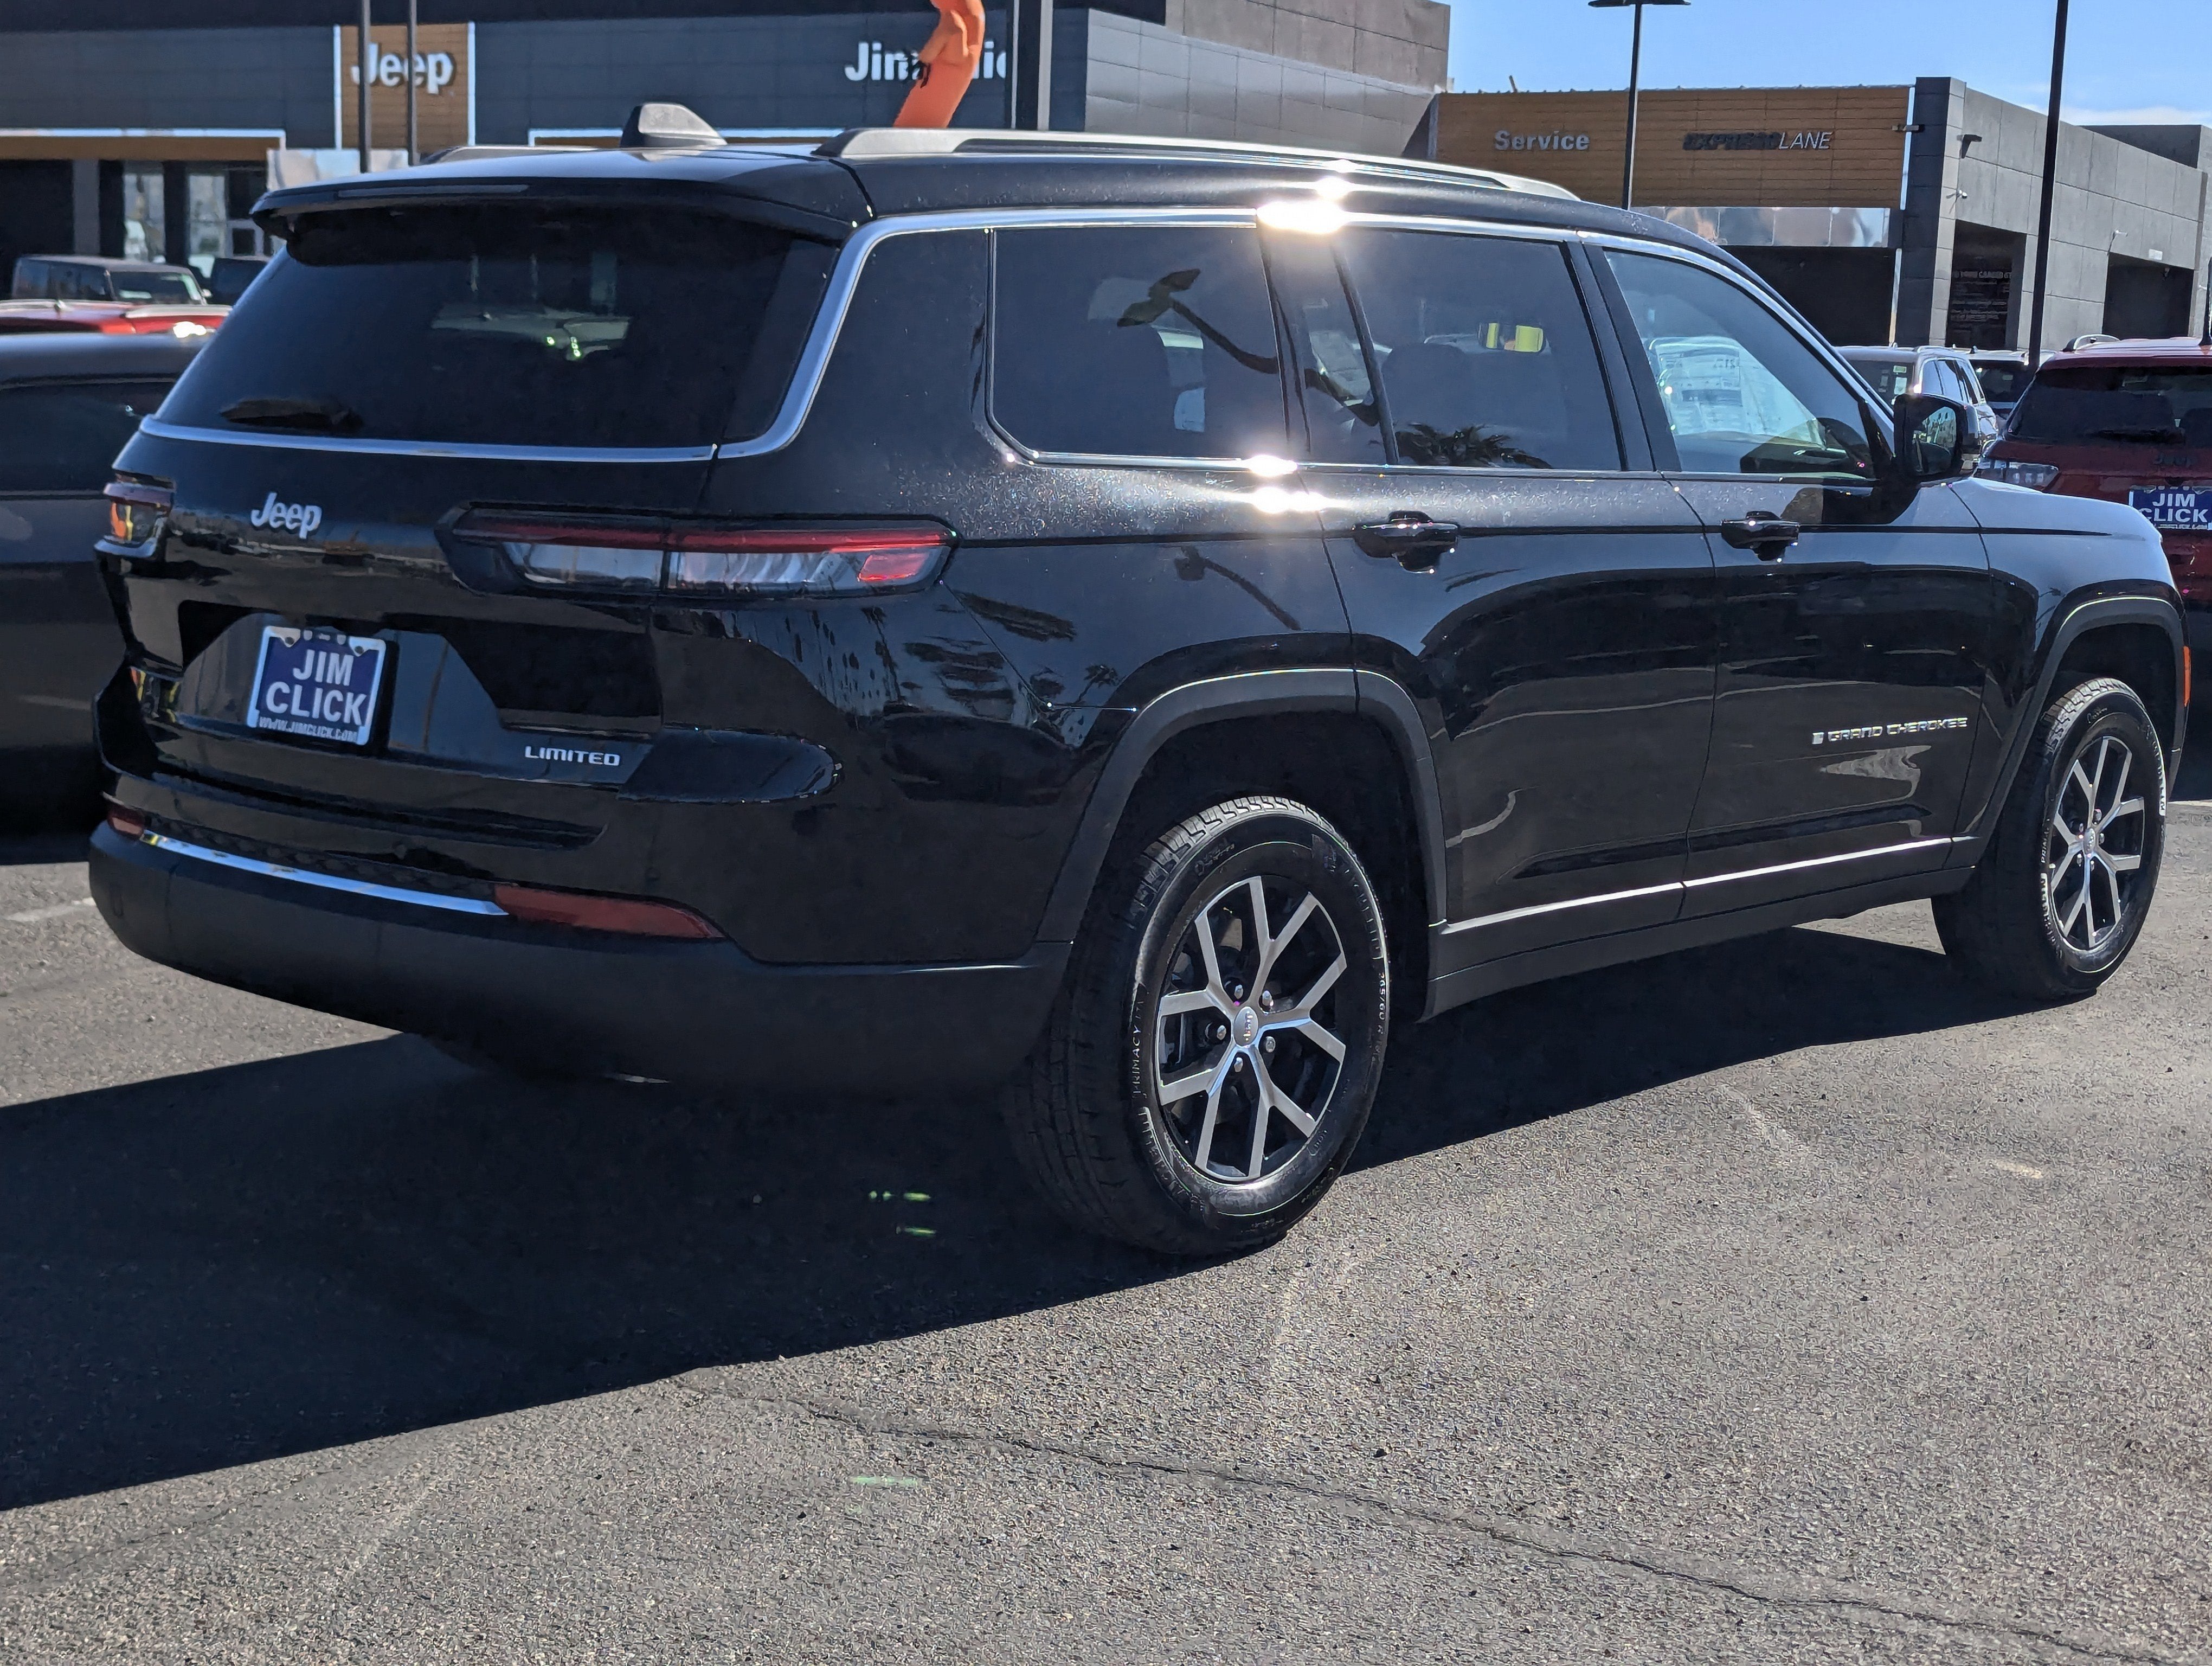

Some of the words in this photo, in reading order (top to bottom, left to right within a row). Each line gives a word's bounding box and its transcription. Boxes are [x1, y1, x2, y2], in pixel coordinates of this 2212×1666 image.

[350, 42, 454, 94] Jeep
[1495, 130, 1590, 150] Service
[1779, 131, 1832, 149] LANE
[2152, 493, 2195, 507] JIM
[251, 492, 322, 539] Jeep
[292, 649, 354, 686] JIM
[266, 681, 367, 726] CLICK
[1828, 726, 1883, 742] GRAND
[1887, 717, 1968, 735] CHEROKEE
[525, 746, 620, 766] LIMITED
